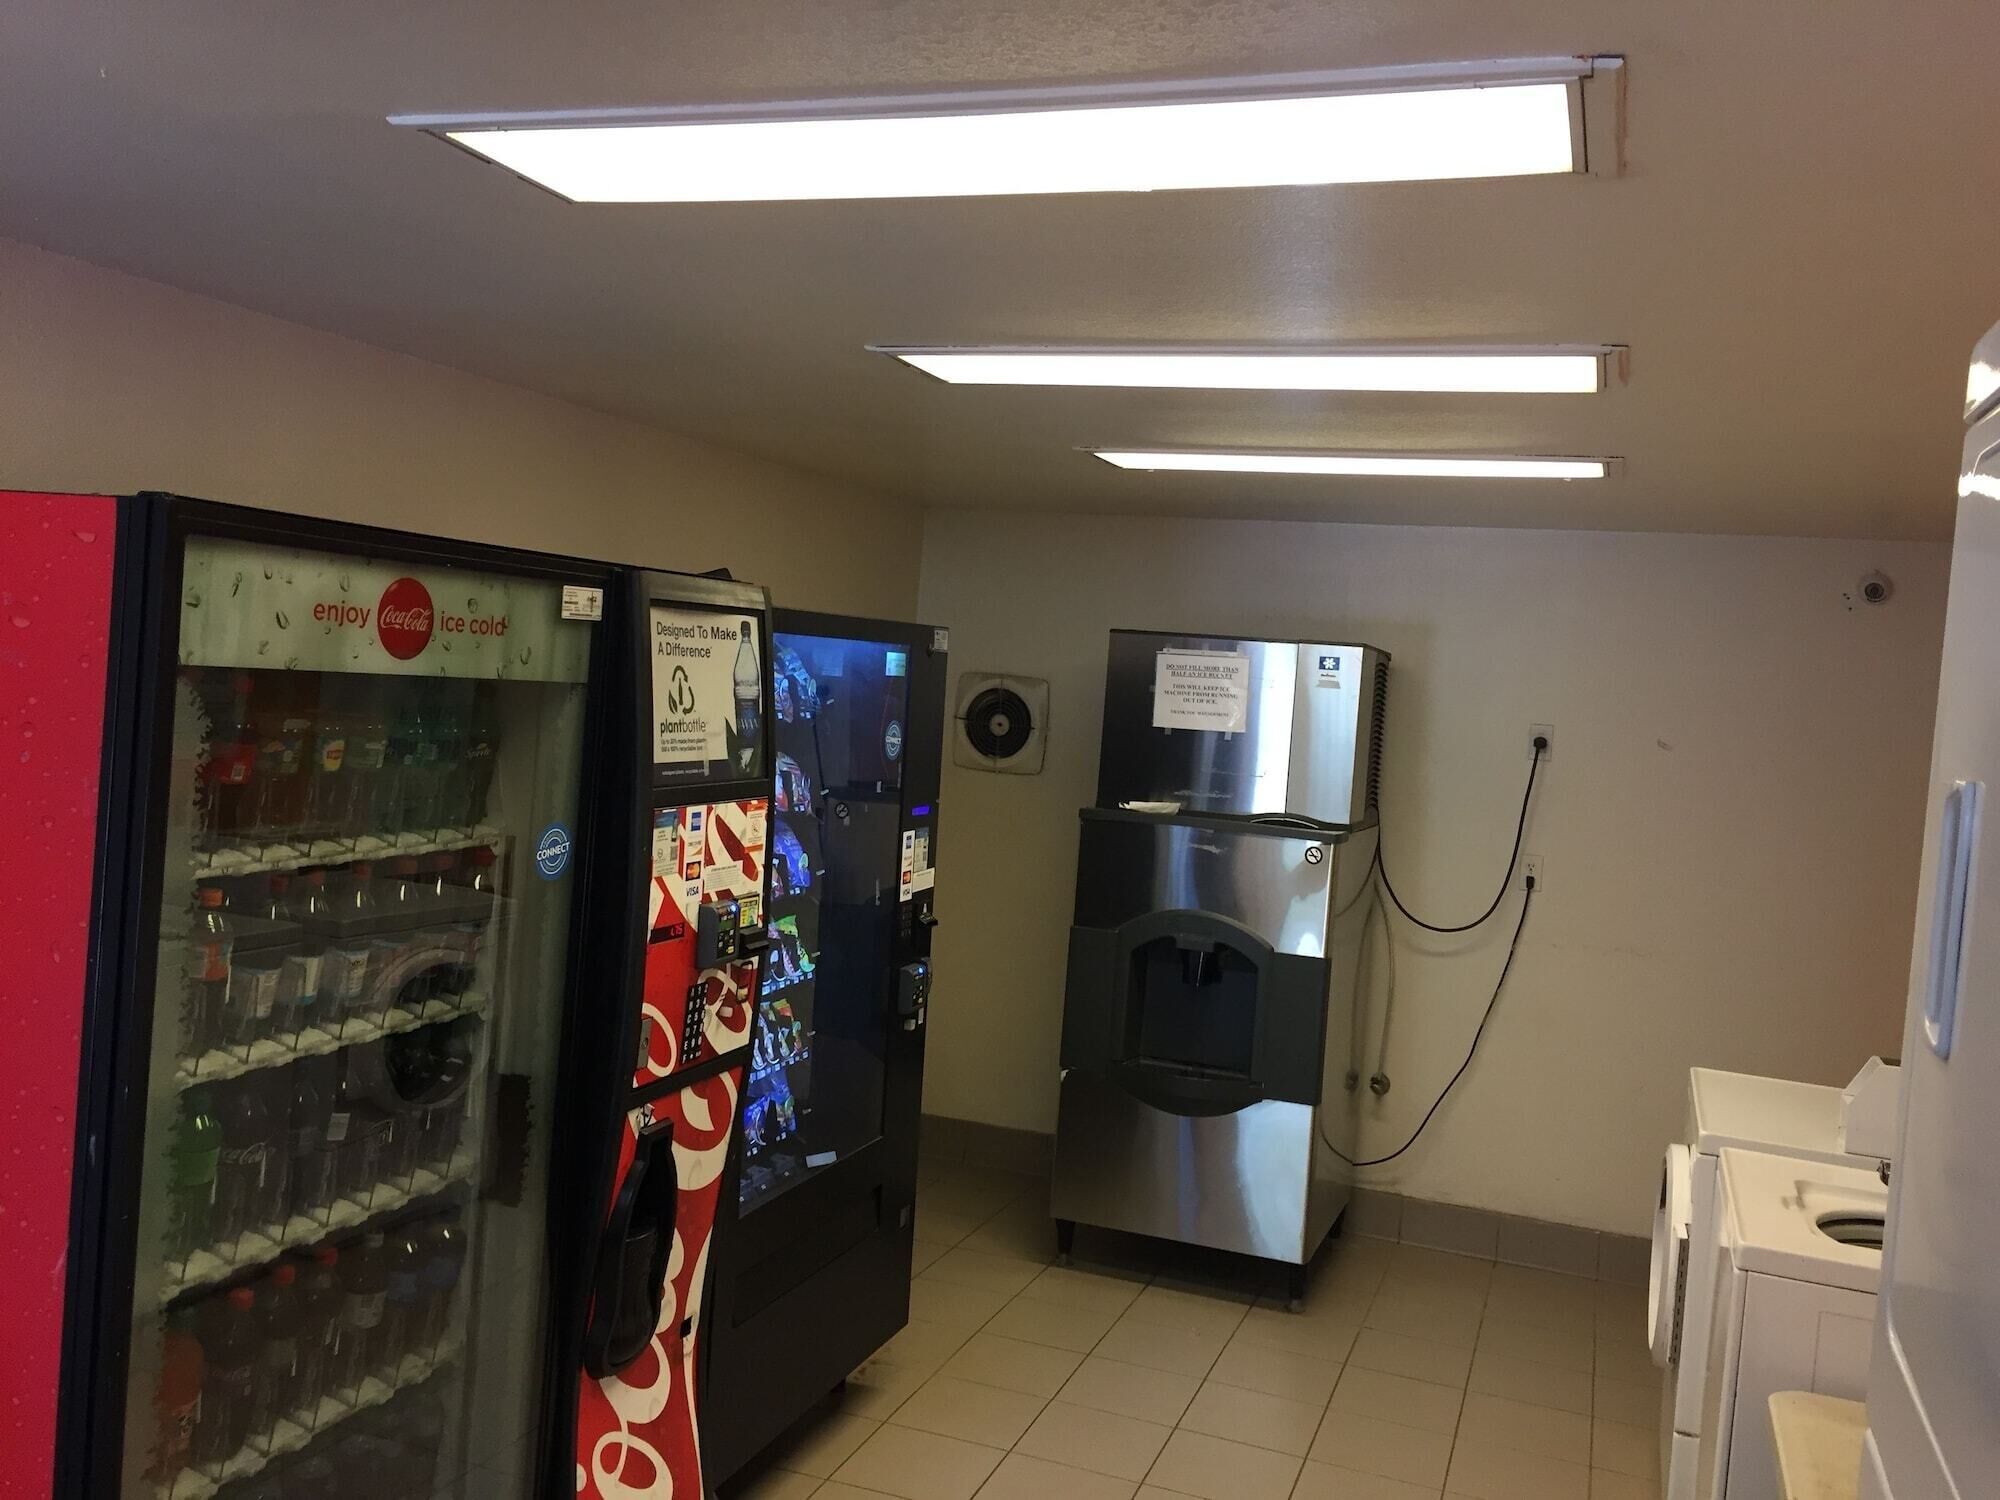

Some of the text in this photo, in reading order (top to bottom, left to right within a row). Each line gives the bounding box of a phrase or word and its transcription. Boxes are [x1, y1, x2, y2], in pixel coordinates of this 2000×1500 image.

[314, 600, 370, 628] enjoy
[380, 605, 432, 631] Coca-Cola
[440, 611, 505, 636] ice cold
[656, 621, 737, 640] Designed To Make
[658, 642, 711, 658] A Difference
[661, 718, 706, 737] plantbottle
[537, 842, 570, 860] CONNECT
[686, 887, 699, 896] VISA
